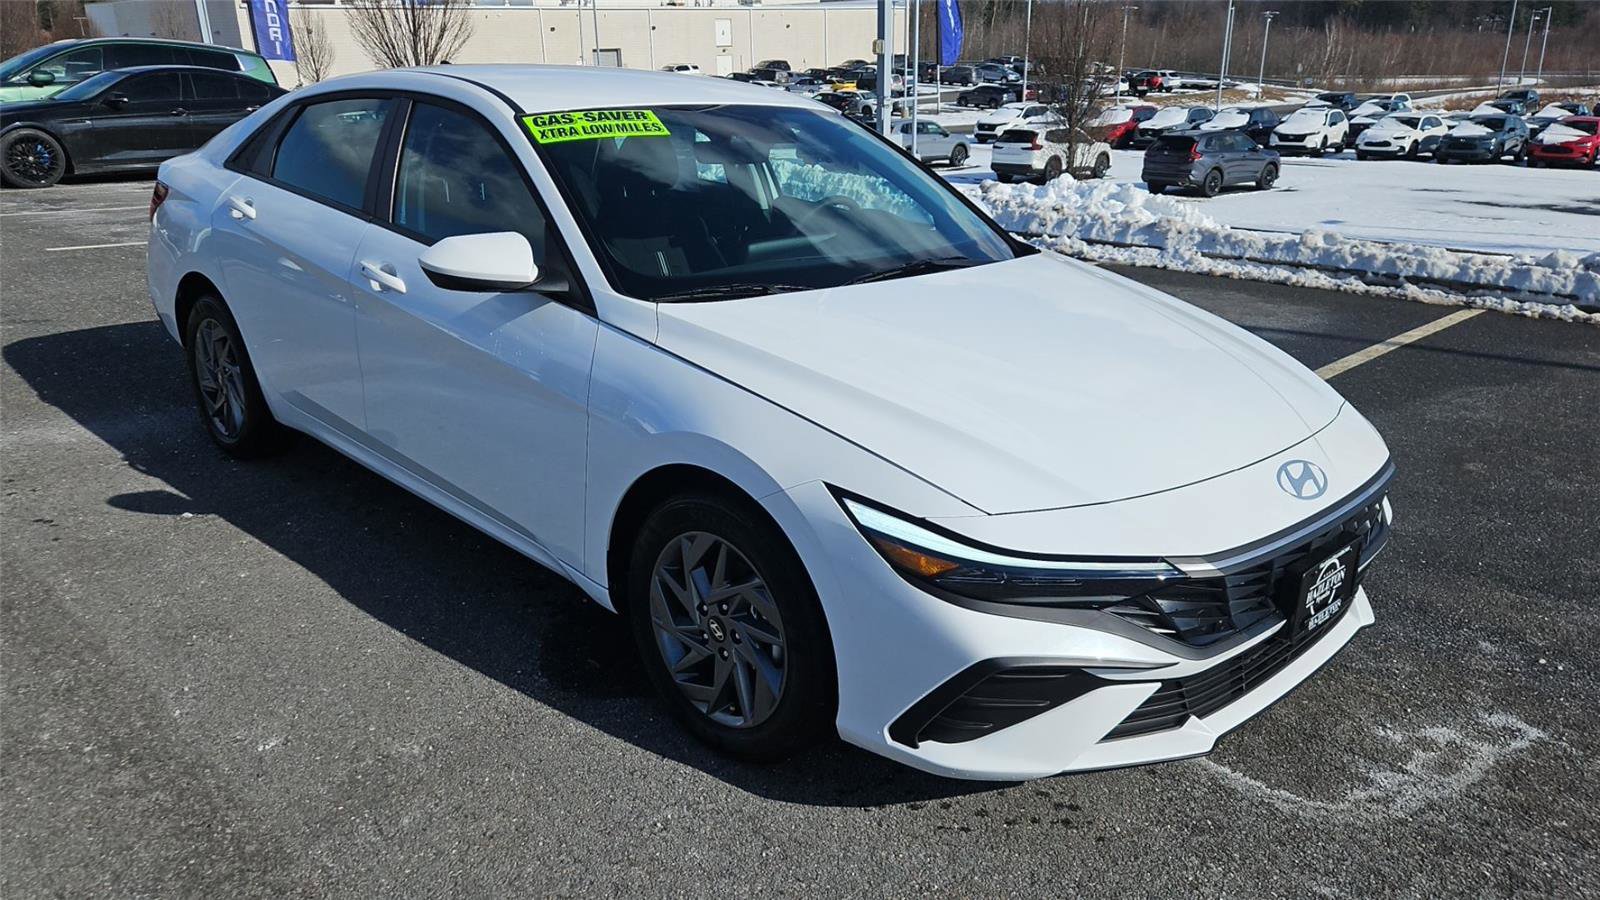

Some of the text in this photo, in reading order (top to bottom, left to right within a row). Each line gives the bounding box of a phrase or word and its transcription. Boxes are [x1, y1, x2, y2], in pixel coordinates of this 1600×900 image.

[532, 111, 648, 128] GAS-SAVER
[538, 121, 662, 140] XTRA LOW MILES
